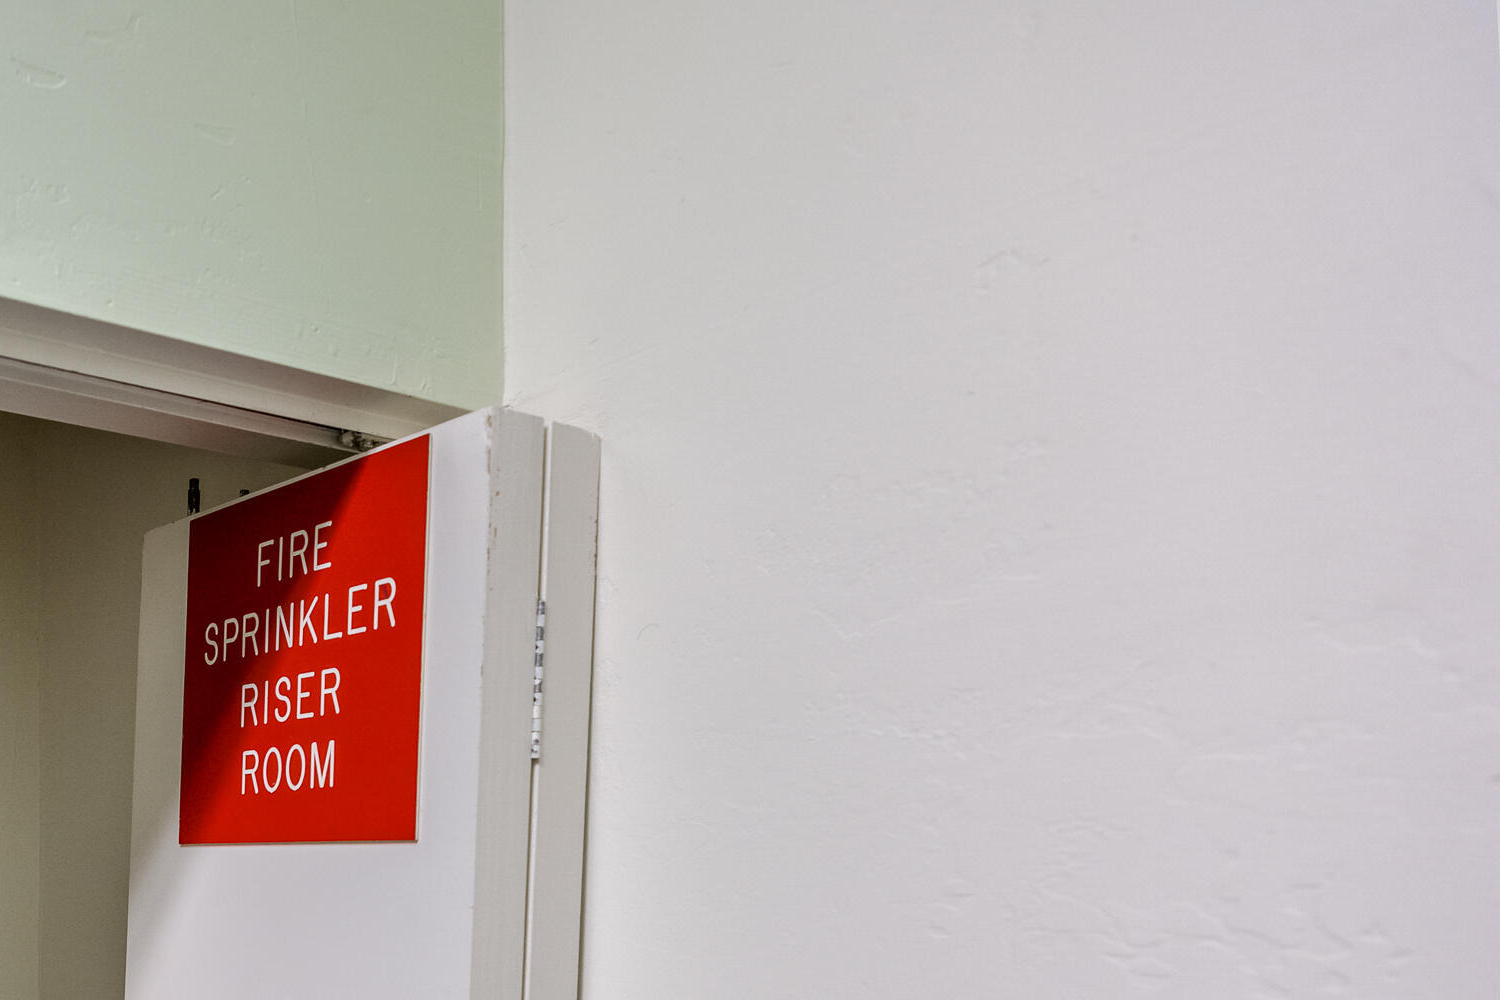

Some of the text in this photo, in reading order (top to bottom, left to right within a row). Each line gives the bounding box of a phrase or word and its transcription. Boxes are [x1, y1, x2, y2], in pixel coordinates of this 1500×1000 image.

[257, 521, 332, 587] FIRE
[204, 577, 397, 666] SPRINKLER
[240, 667, 341, 728] RISER
[241, 740, 335, 795] ROOM
